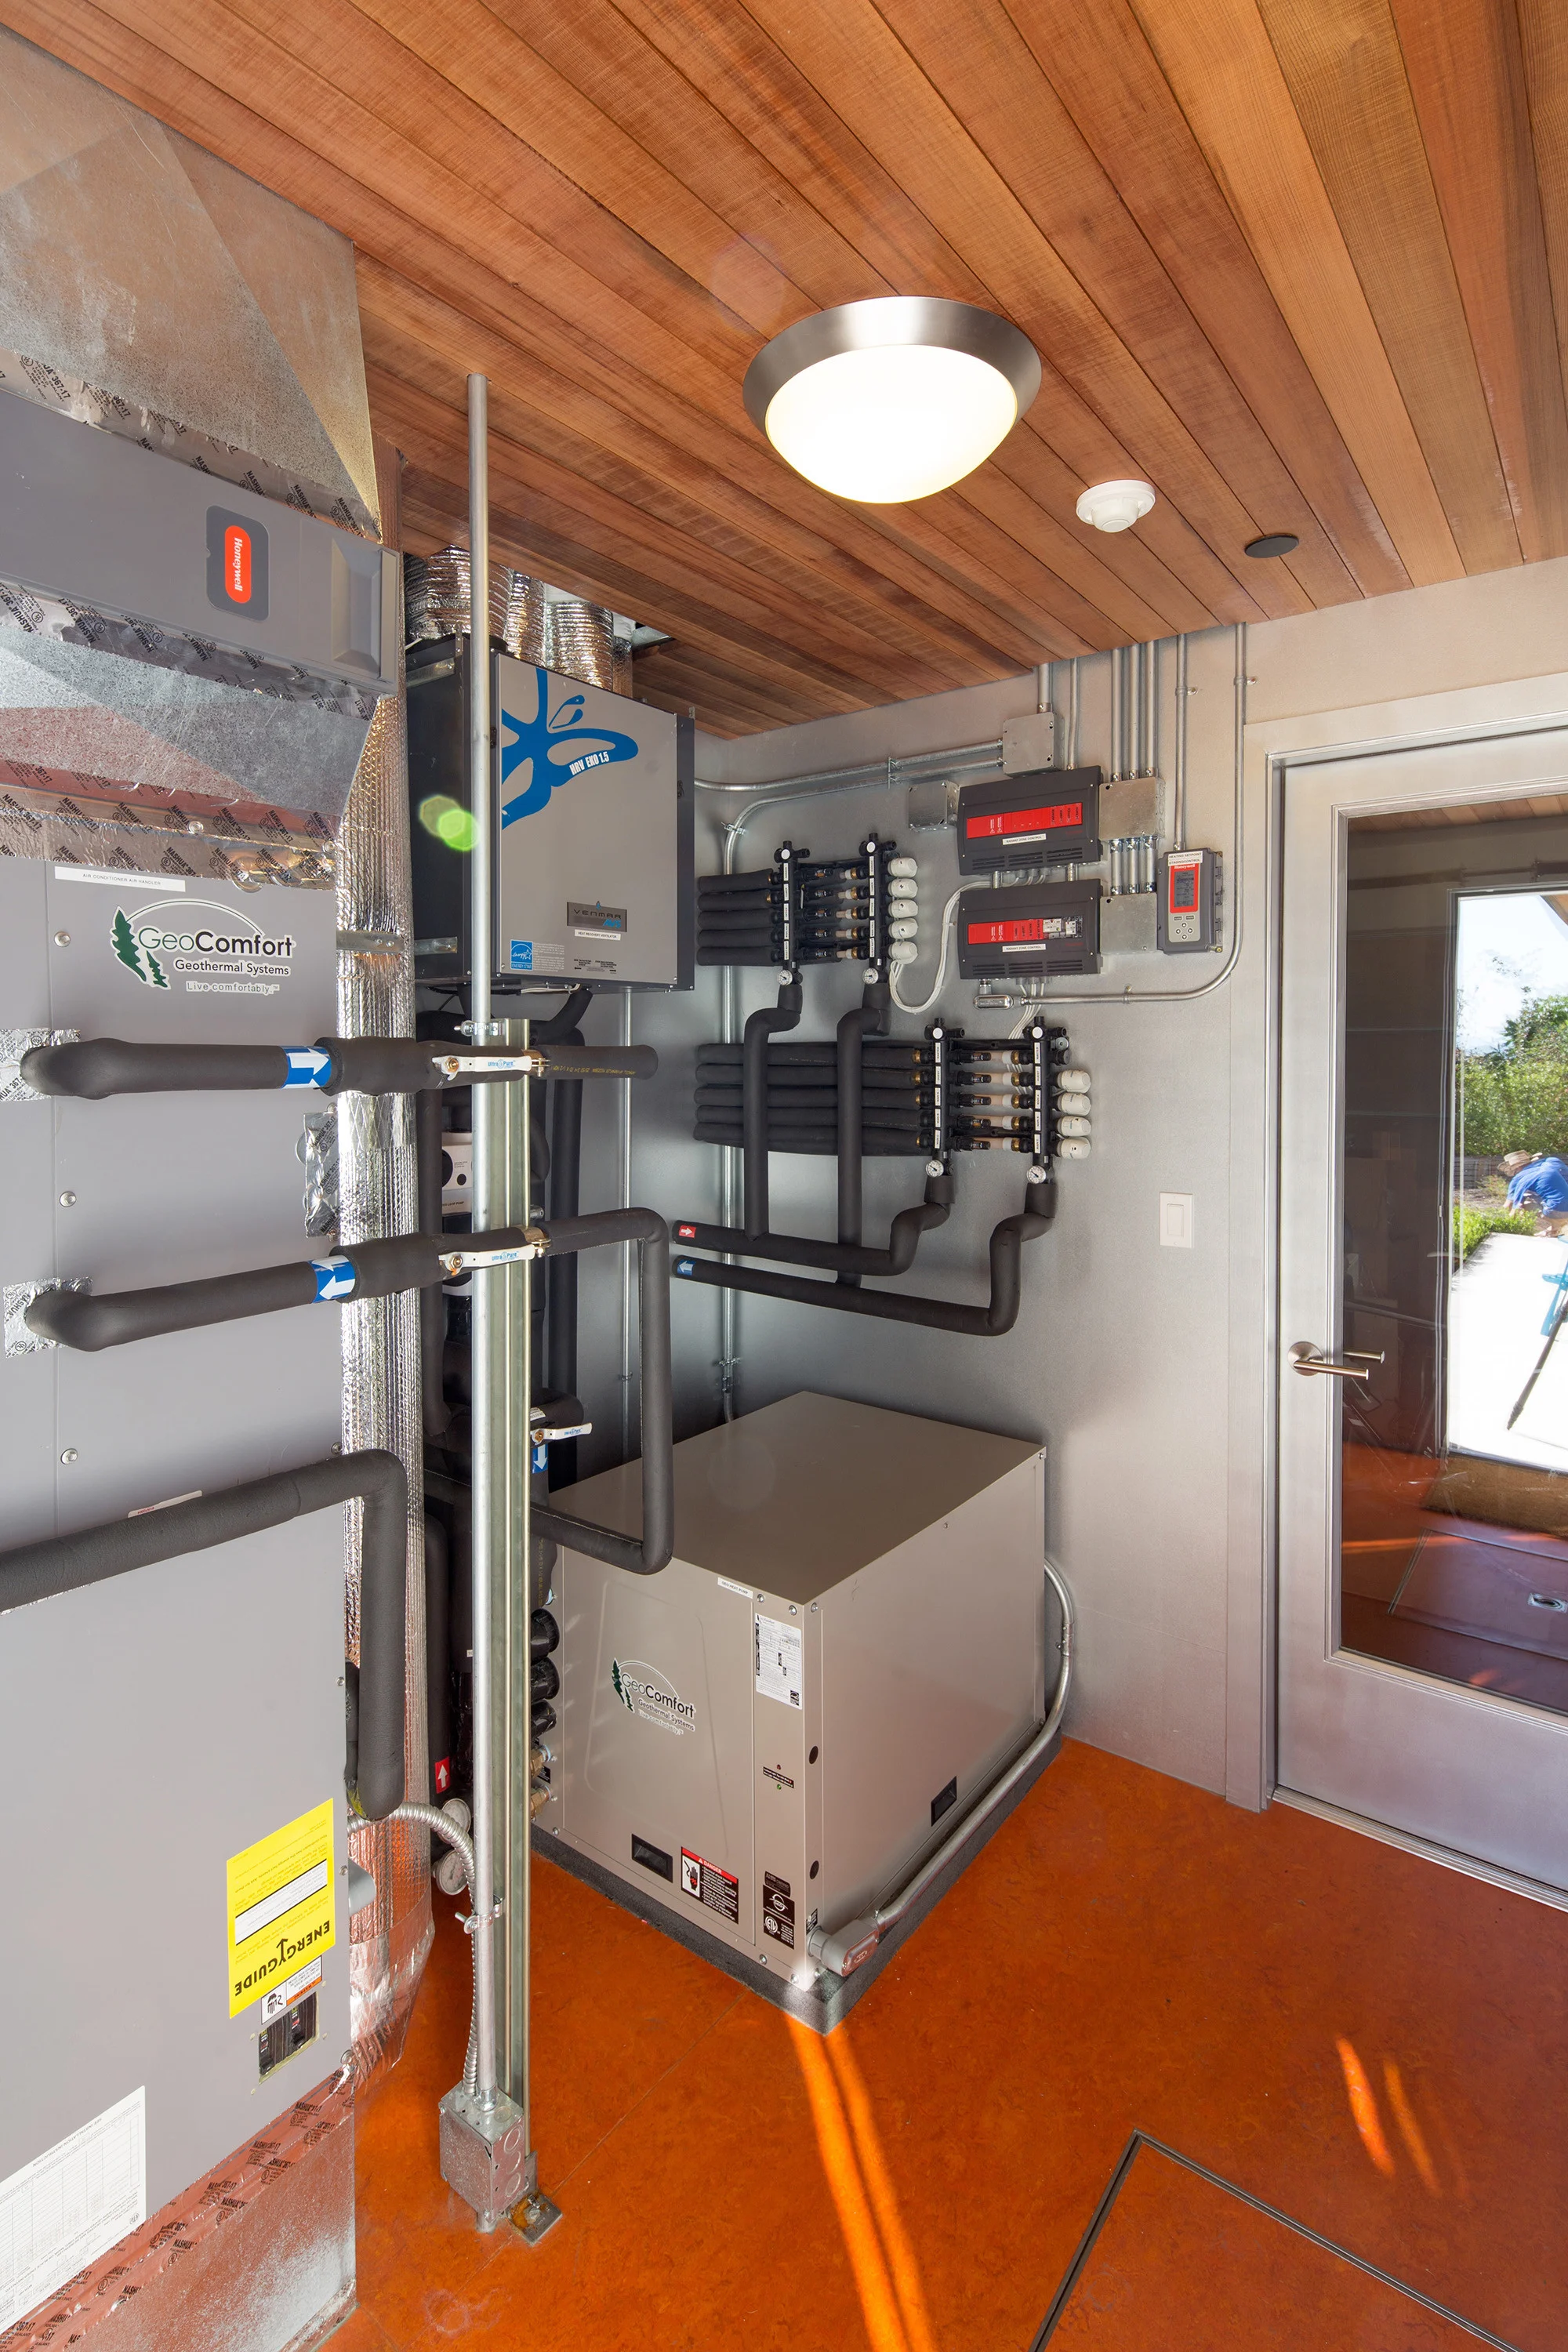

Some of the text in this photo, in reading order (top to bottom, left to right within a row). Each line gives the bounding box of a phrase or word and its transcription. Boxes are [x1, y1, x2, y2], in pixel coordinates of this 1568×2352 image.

[232, 537, 243, 591] Honeywell
[568, 751, 610, 775] HRV EKO 1.5
[93, 874, 128, 883] CONDITIONER
[138, 927, 292, 956] GeoComfort
[175, 960, 289, 976] Geothermal Systems
[187, 982, 209, 991] Live
[621, 1673, 694, 1718] GeoComfort
[638, 1699, 695, 1731] Geothermal Systems
[703, 1860, 722, 1875] DANGER
[234, 1920, 330, 1996] ENERGYGUIDE
